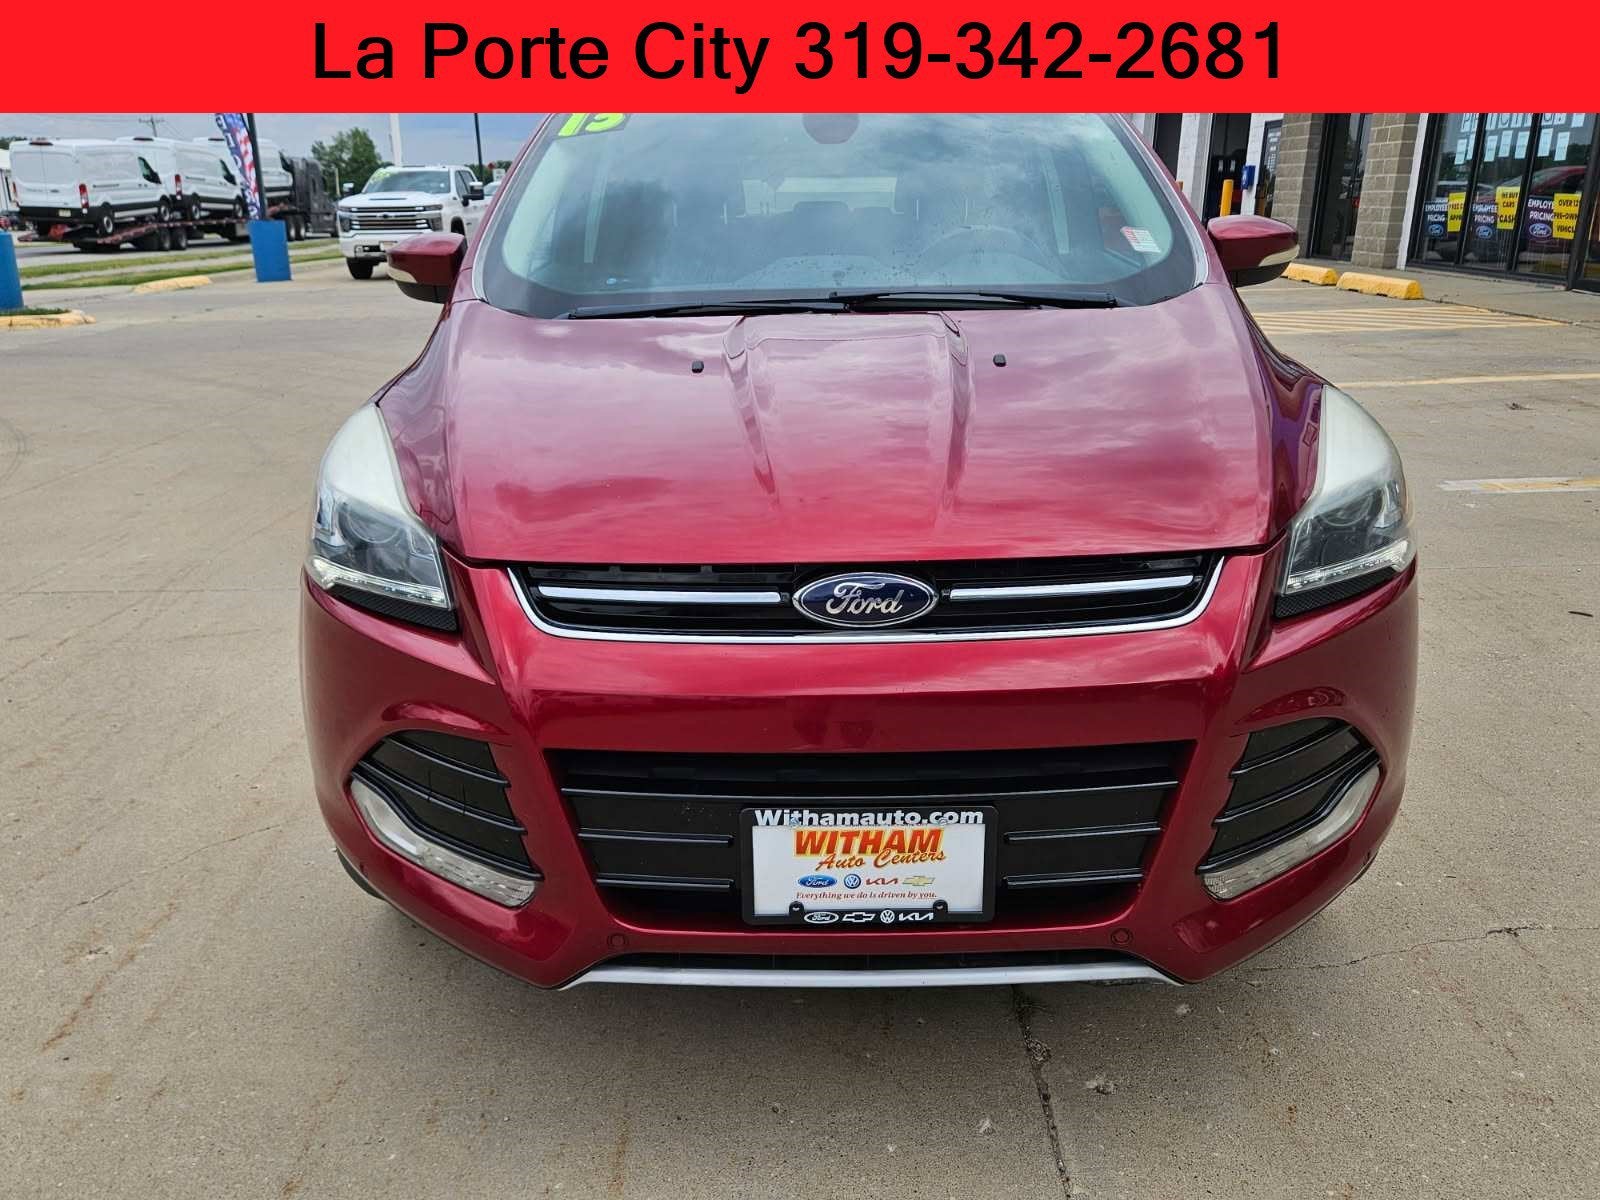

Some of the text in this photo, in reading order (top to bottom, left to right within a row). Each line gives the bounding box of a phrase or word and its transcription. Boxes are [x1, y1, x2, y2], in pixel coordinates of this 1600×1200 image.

[825, 581, 905, 615] Ford
[754, 808, 984, 827] Withamauto.com
[795, 828, 944, 855] WITHAM
[815, 847, 946, 871] Auto Centers
[796, 891, 842, 901] Everything
[854, 891, 868, 900] do
[878, 890, 906, 899] driven
[907, 891, 918, 901] by
[918, 892, 937, 901] you.
